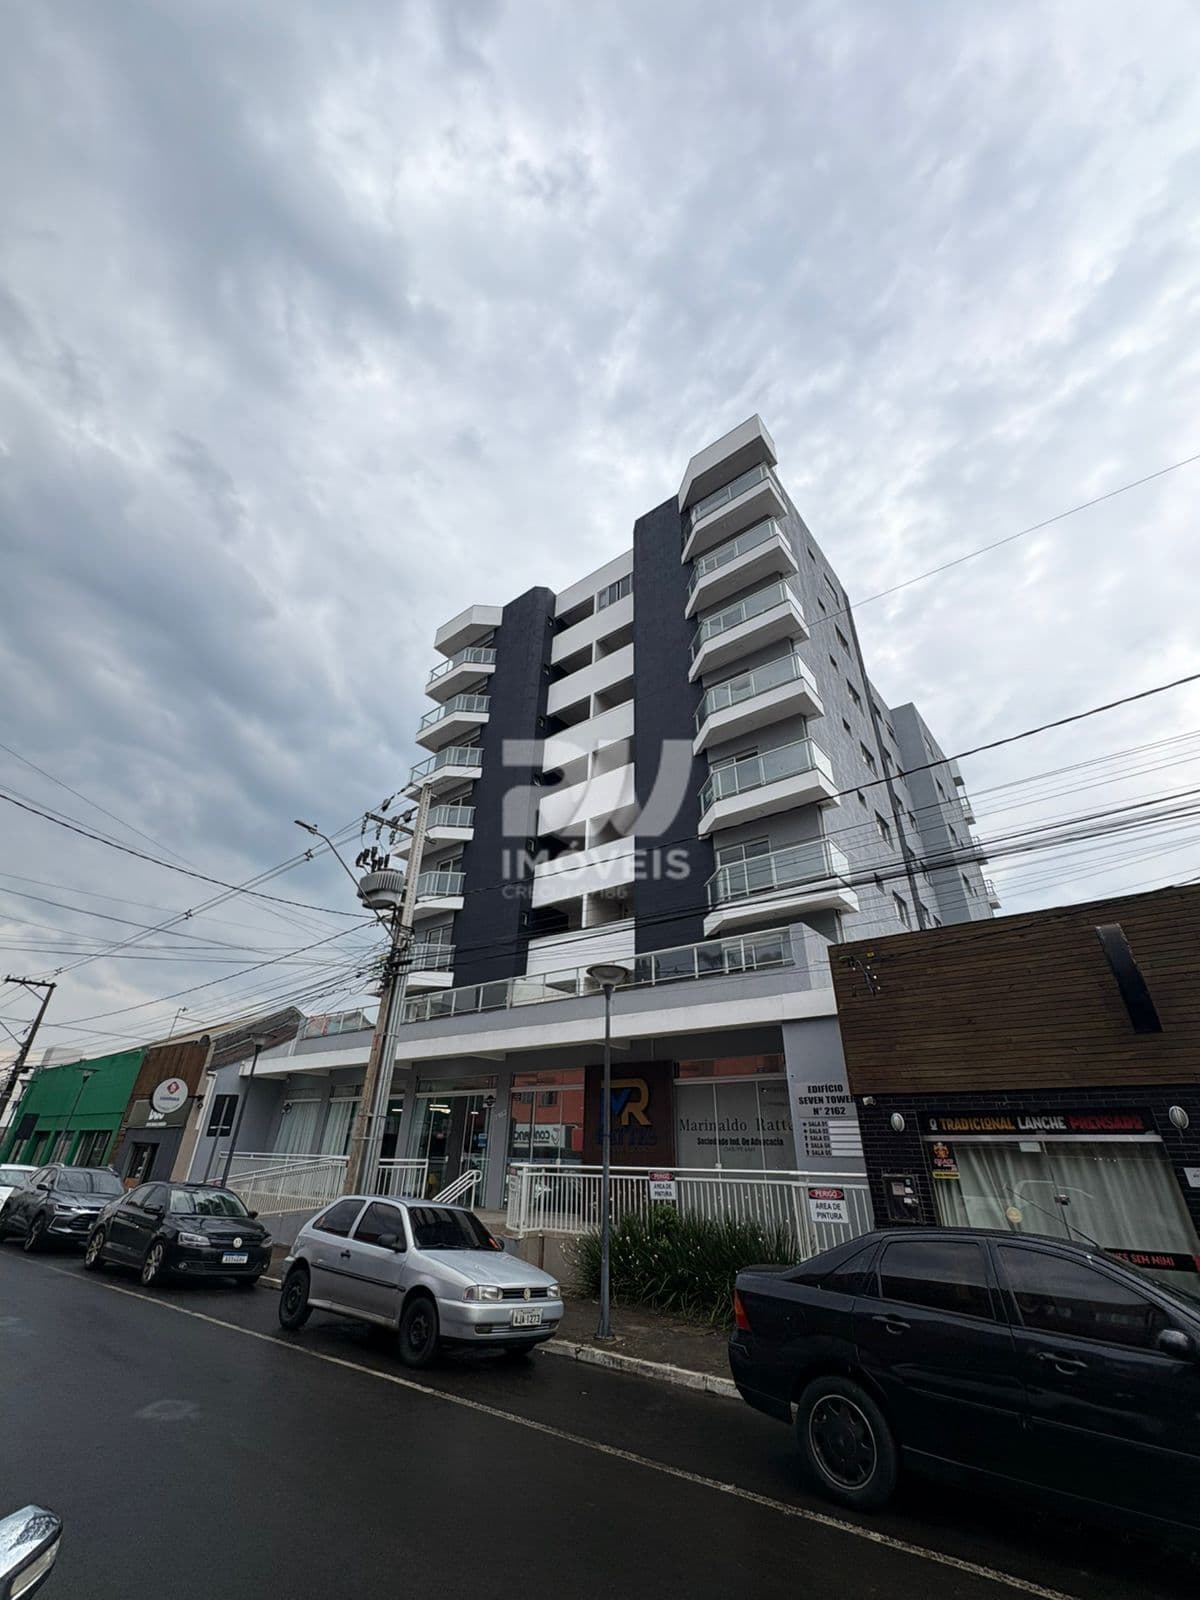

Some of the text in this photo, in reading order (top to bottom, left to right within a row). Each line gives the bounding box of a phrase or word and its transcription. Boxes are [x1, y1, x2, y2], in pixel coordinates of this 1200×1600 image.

[808, 1083, 843, 1093] EDIFÍCIO
[799, 1096, 824, 1104] SEVEN
[824, 1106, 846, 1115] 2162
[679, 1118, 747, 1131] Marinaldo
[939, 1116, 1016, 1130] TRADICIONAL
[1017, 1115, 1067, 1130] LANCHE
[832, 1202, 841, 1210] DE
[816, 1211, 843, 1220] PINTURA
